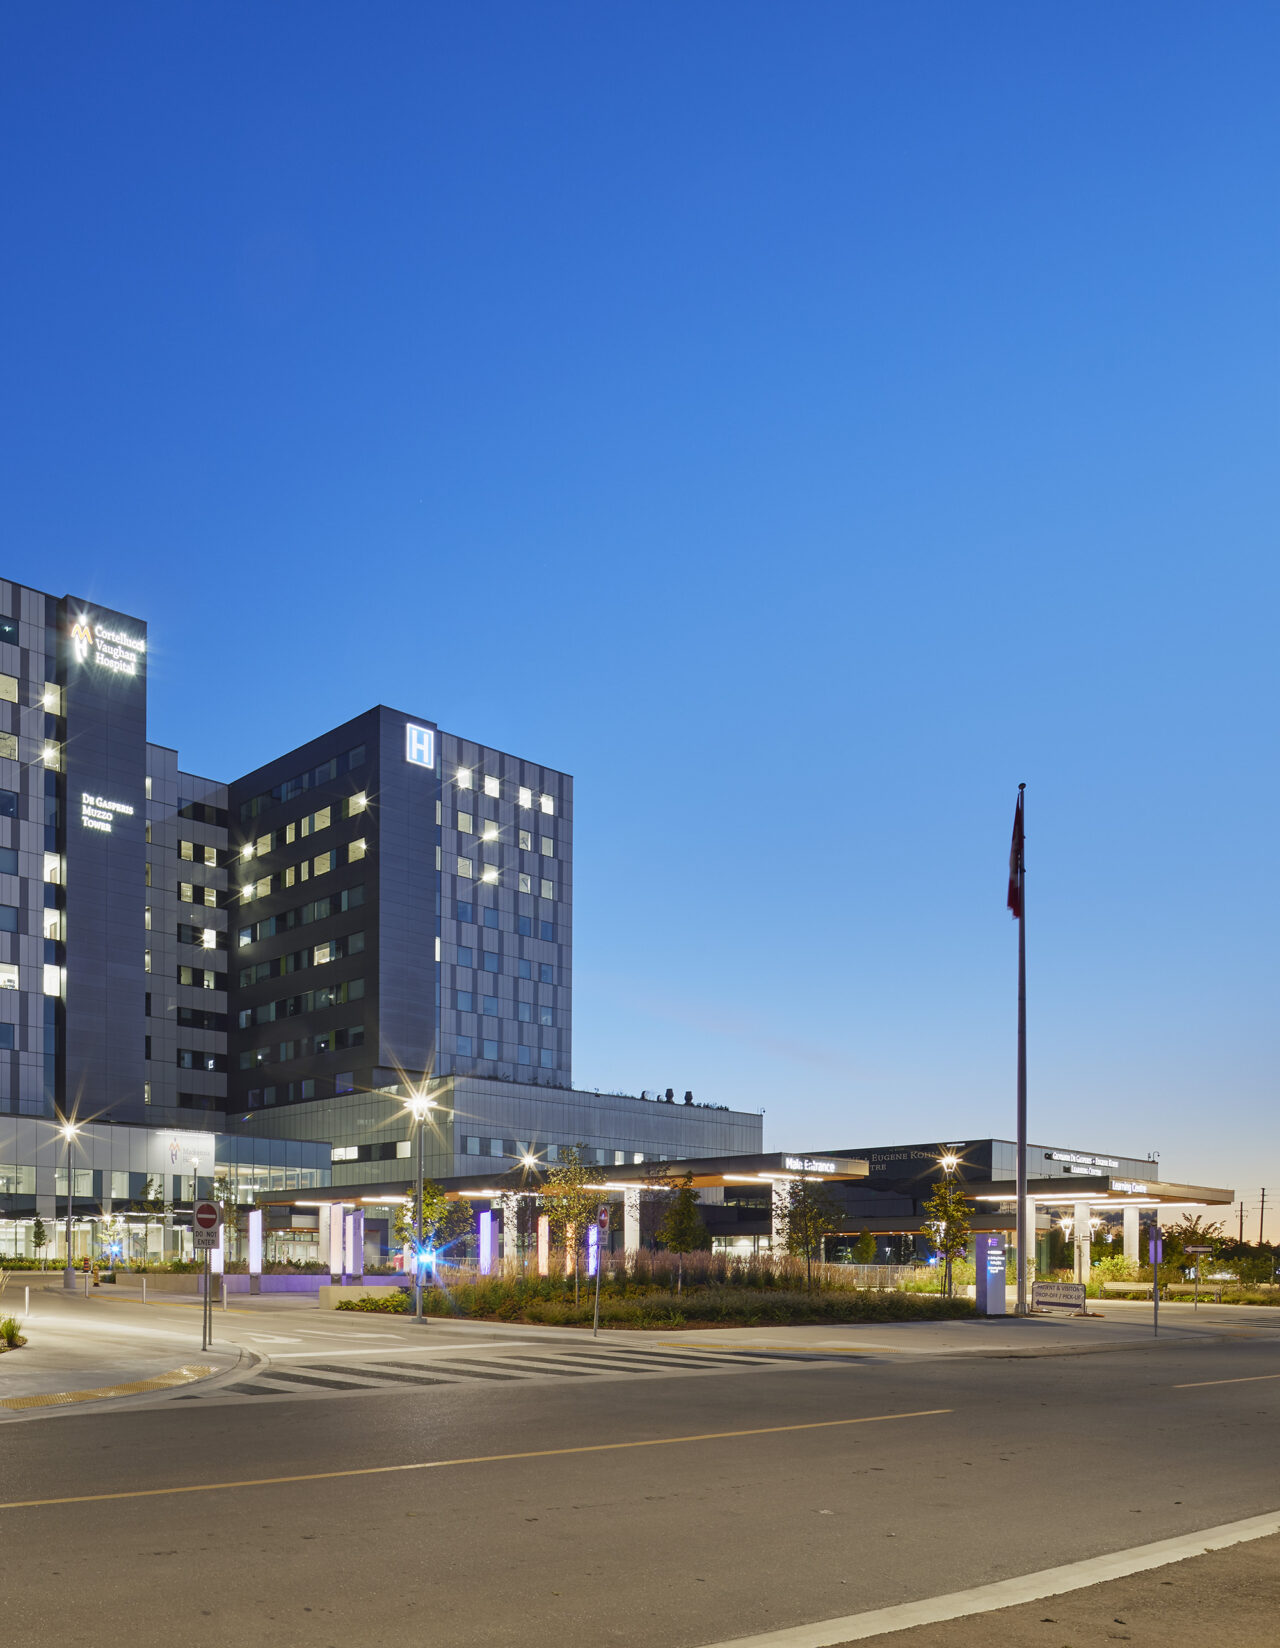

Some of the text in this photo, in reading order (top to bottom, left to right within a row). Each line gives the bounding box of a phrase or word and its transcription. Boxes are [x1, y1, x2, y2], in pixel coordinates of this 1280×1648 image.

[95, 625, 145, 652] Cortellucci
[95, 638, 136, 663] Vaughan
[95, 652, 136, 675] Hospital
[785, 1157, 836, 1172] Main Entrance
[195, 1230, 204, 1238] DO
